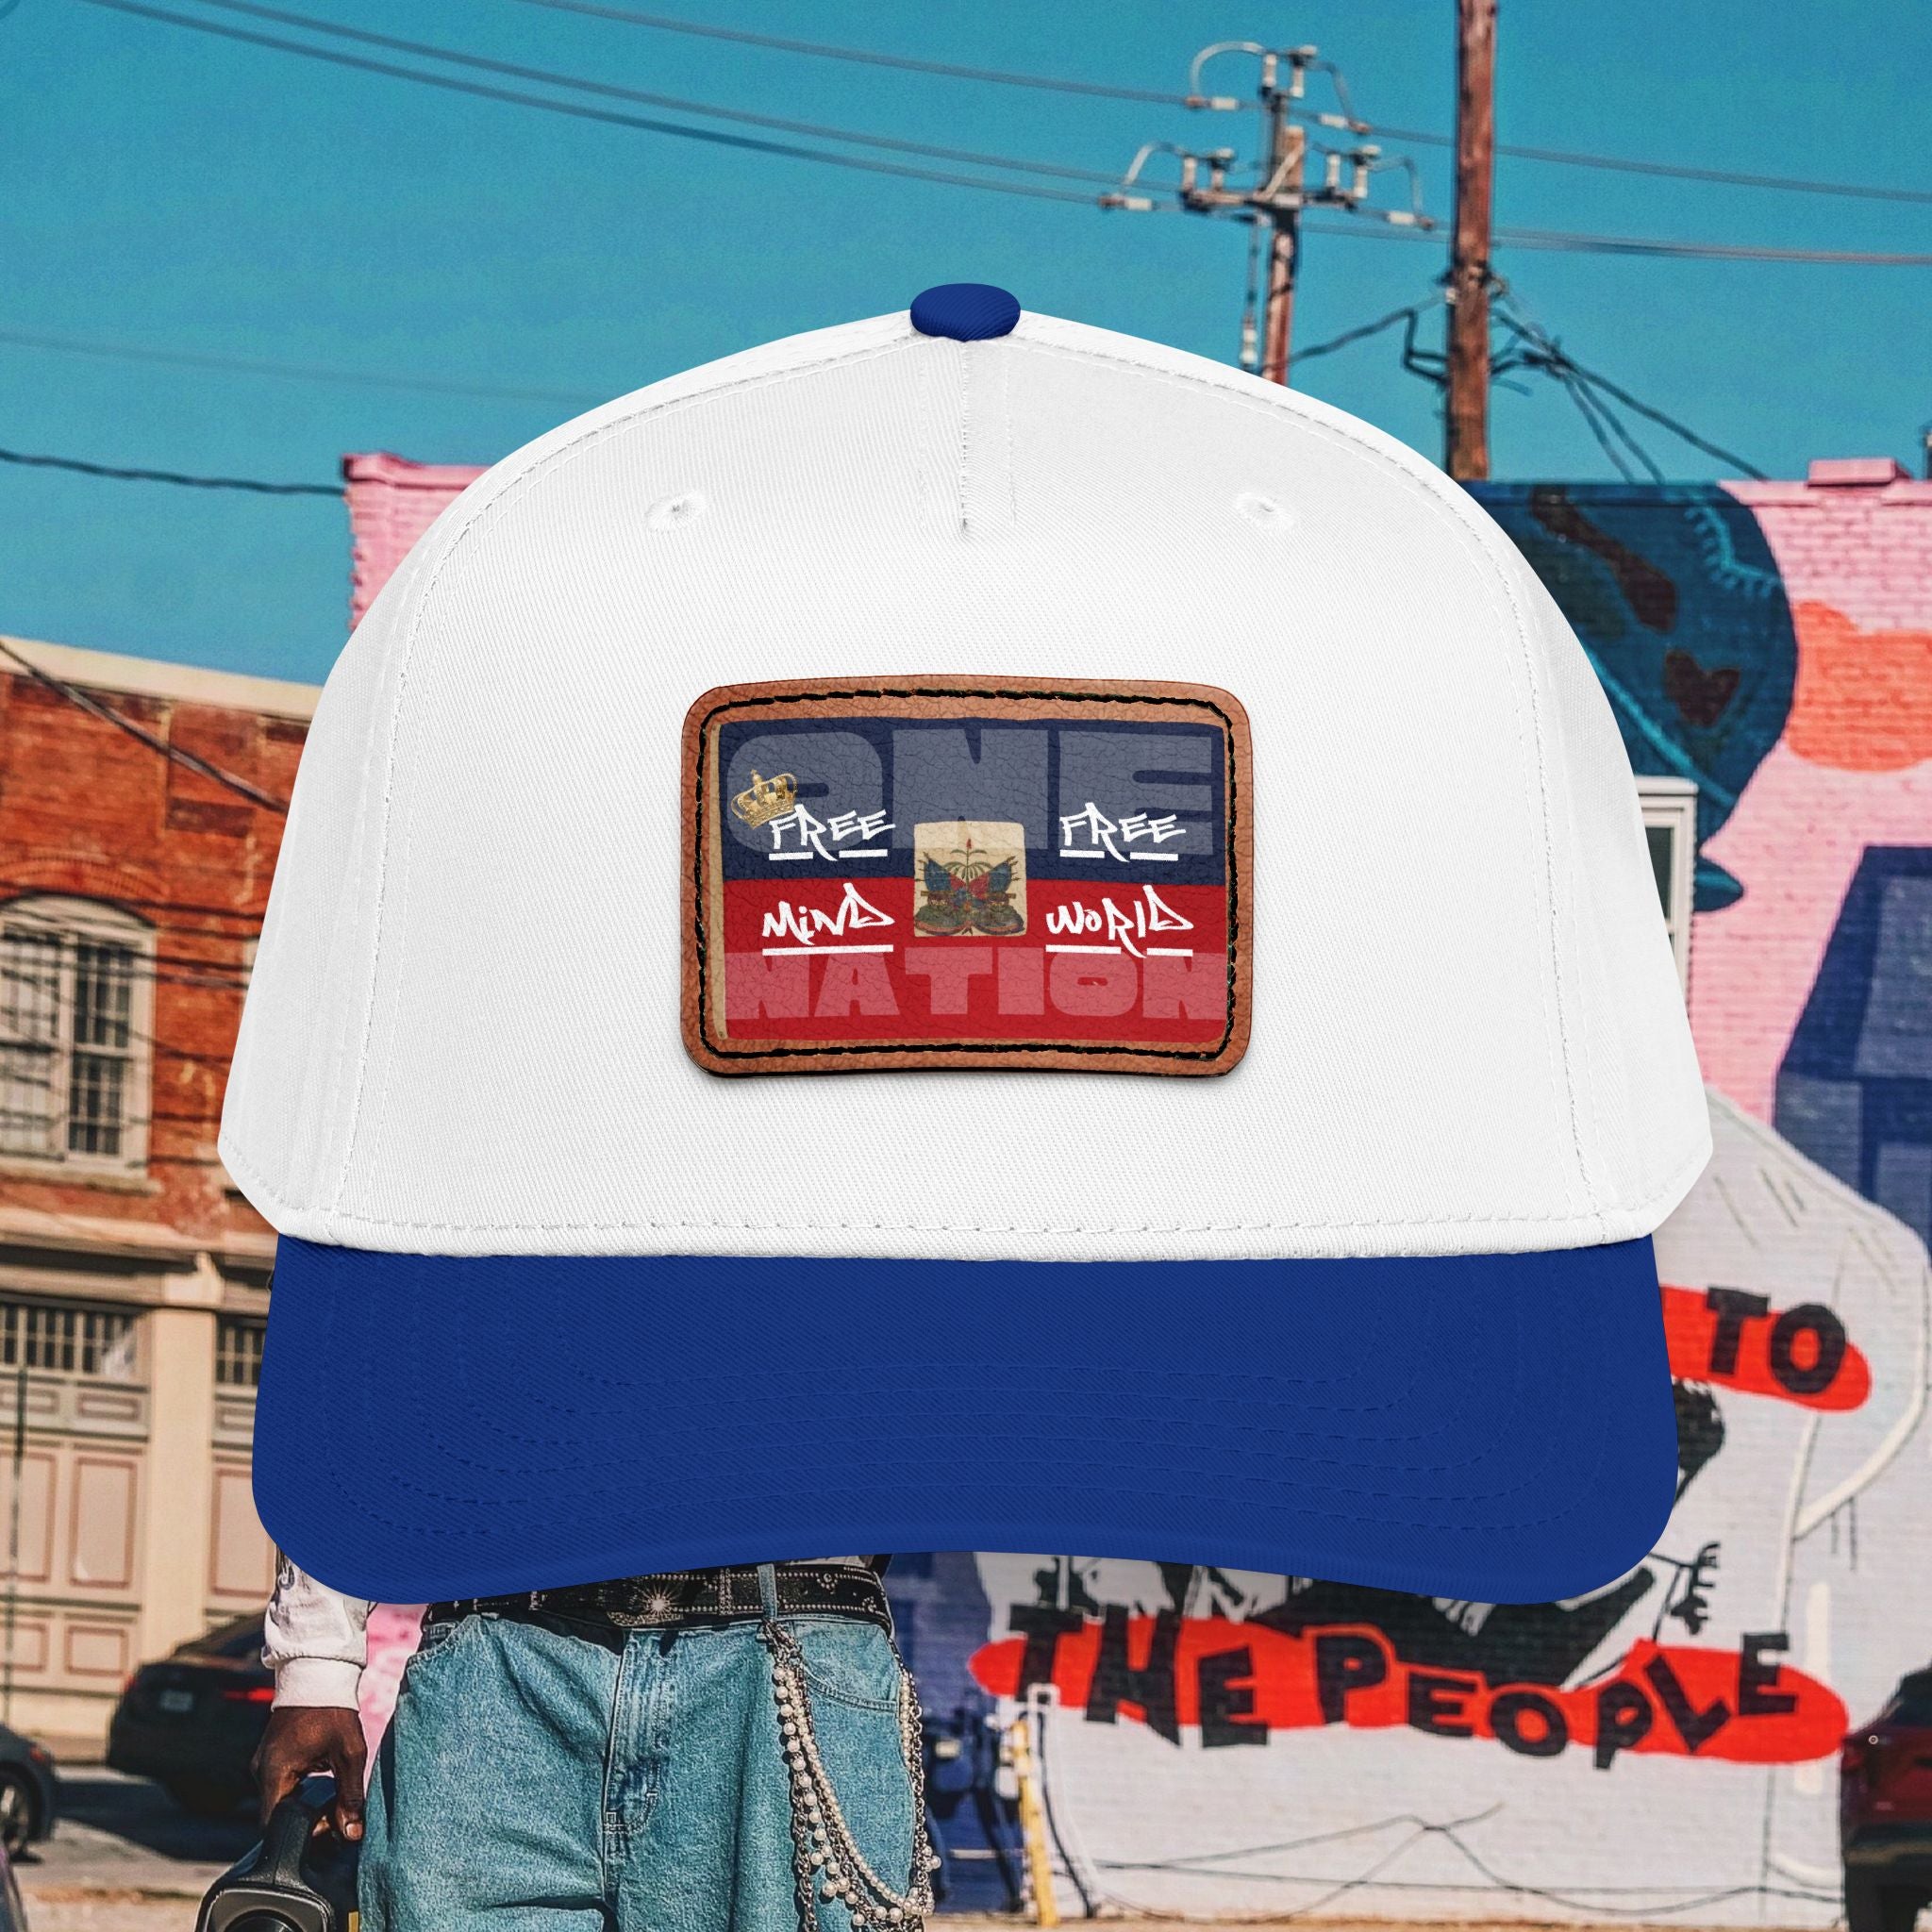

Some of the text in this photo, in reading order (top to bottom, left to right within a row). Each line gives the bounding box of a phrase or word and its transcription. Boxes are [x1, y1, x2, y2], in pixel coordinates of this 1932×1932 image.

[726, 728, 1213, 856] ONE
[769, 804, 895, 861] FREE
[1060, 802, 1186, 862] FREE
[724, 946, 1227, 1020] NATION
[1707, 1286, 1846, 1395] TO
[1009, 1603, 1798, 1770] THE PEOPLE
